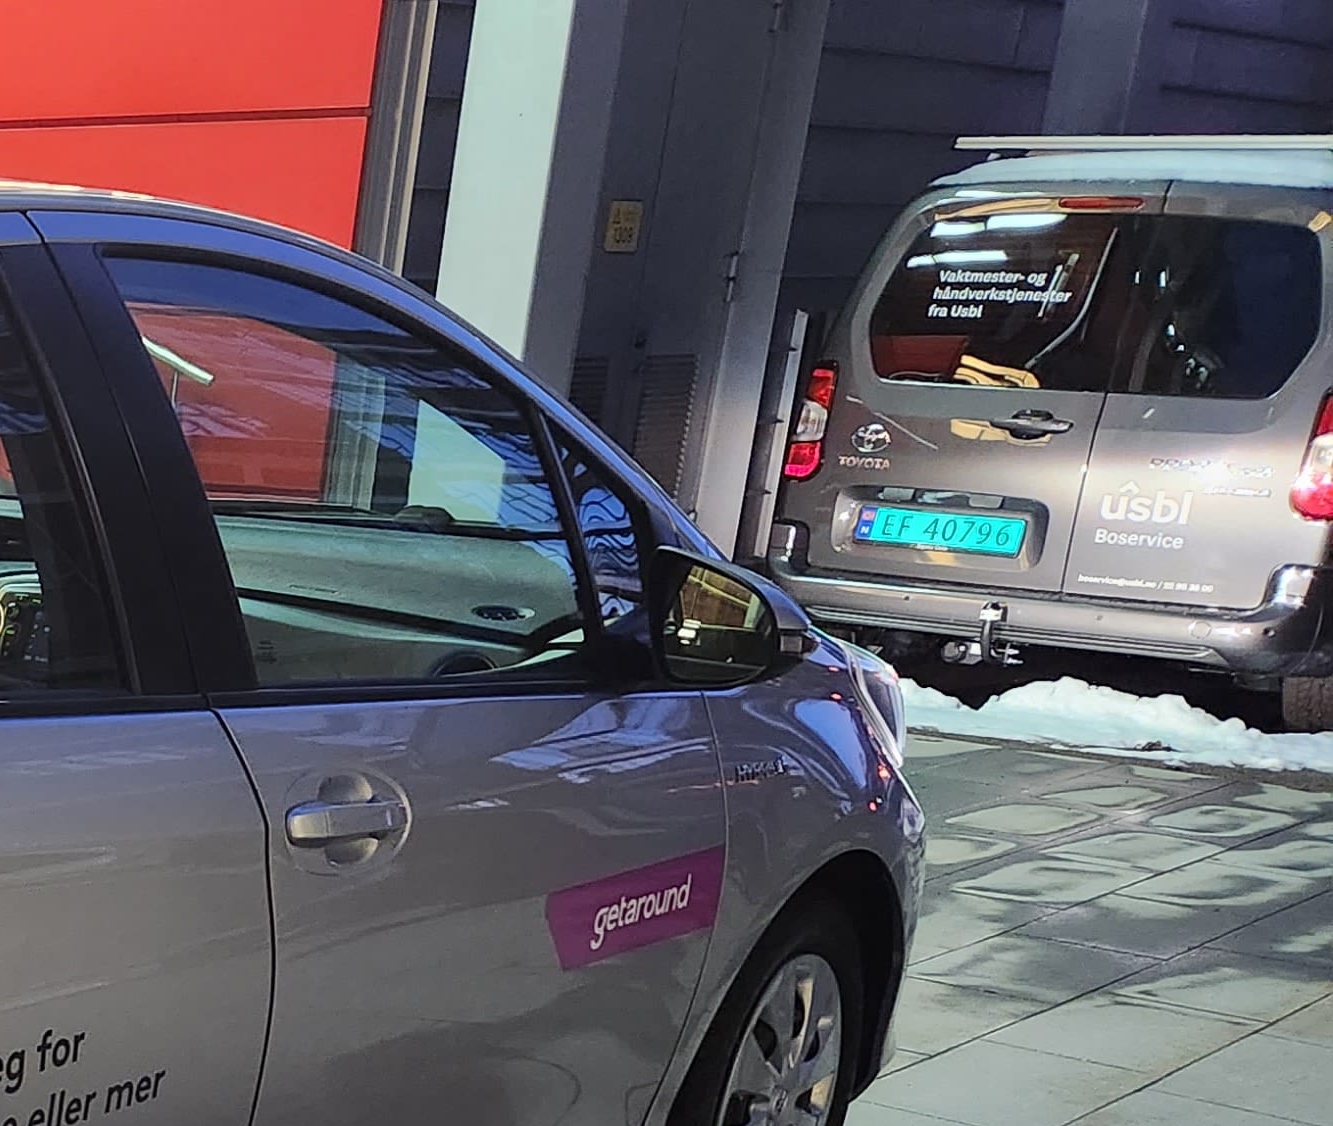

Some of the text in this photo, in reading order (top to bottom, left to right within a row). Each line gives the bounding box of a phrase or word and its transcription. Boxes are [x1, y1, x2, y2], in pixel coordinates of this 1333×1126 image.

[939, 270, 1048, 287] Vaktmester- og
[933, 286, 1073, 304] håndverkstjenester
[927, 304, 984, 319] fra Usbl
[838, 456, 891, 470] TOYOTA
[882, 514, 913, 538] EF
[923, 517, 1013, 547] 40796
[1094, 528, 1185, 550] Boservice
[590, 873, 693, 951] getaround
[36, 1029, 86, 1073] for
[103, 1069, 166, 1115] mer
